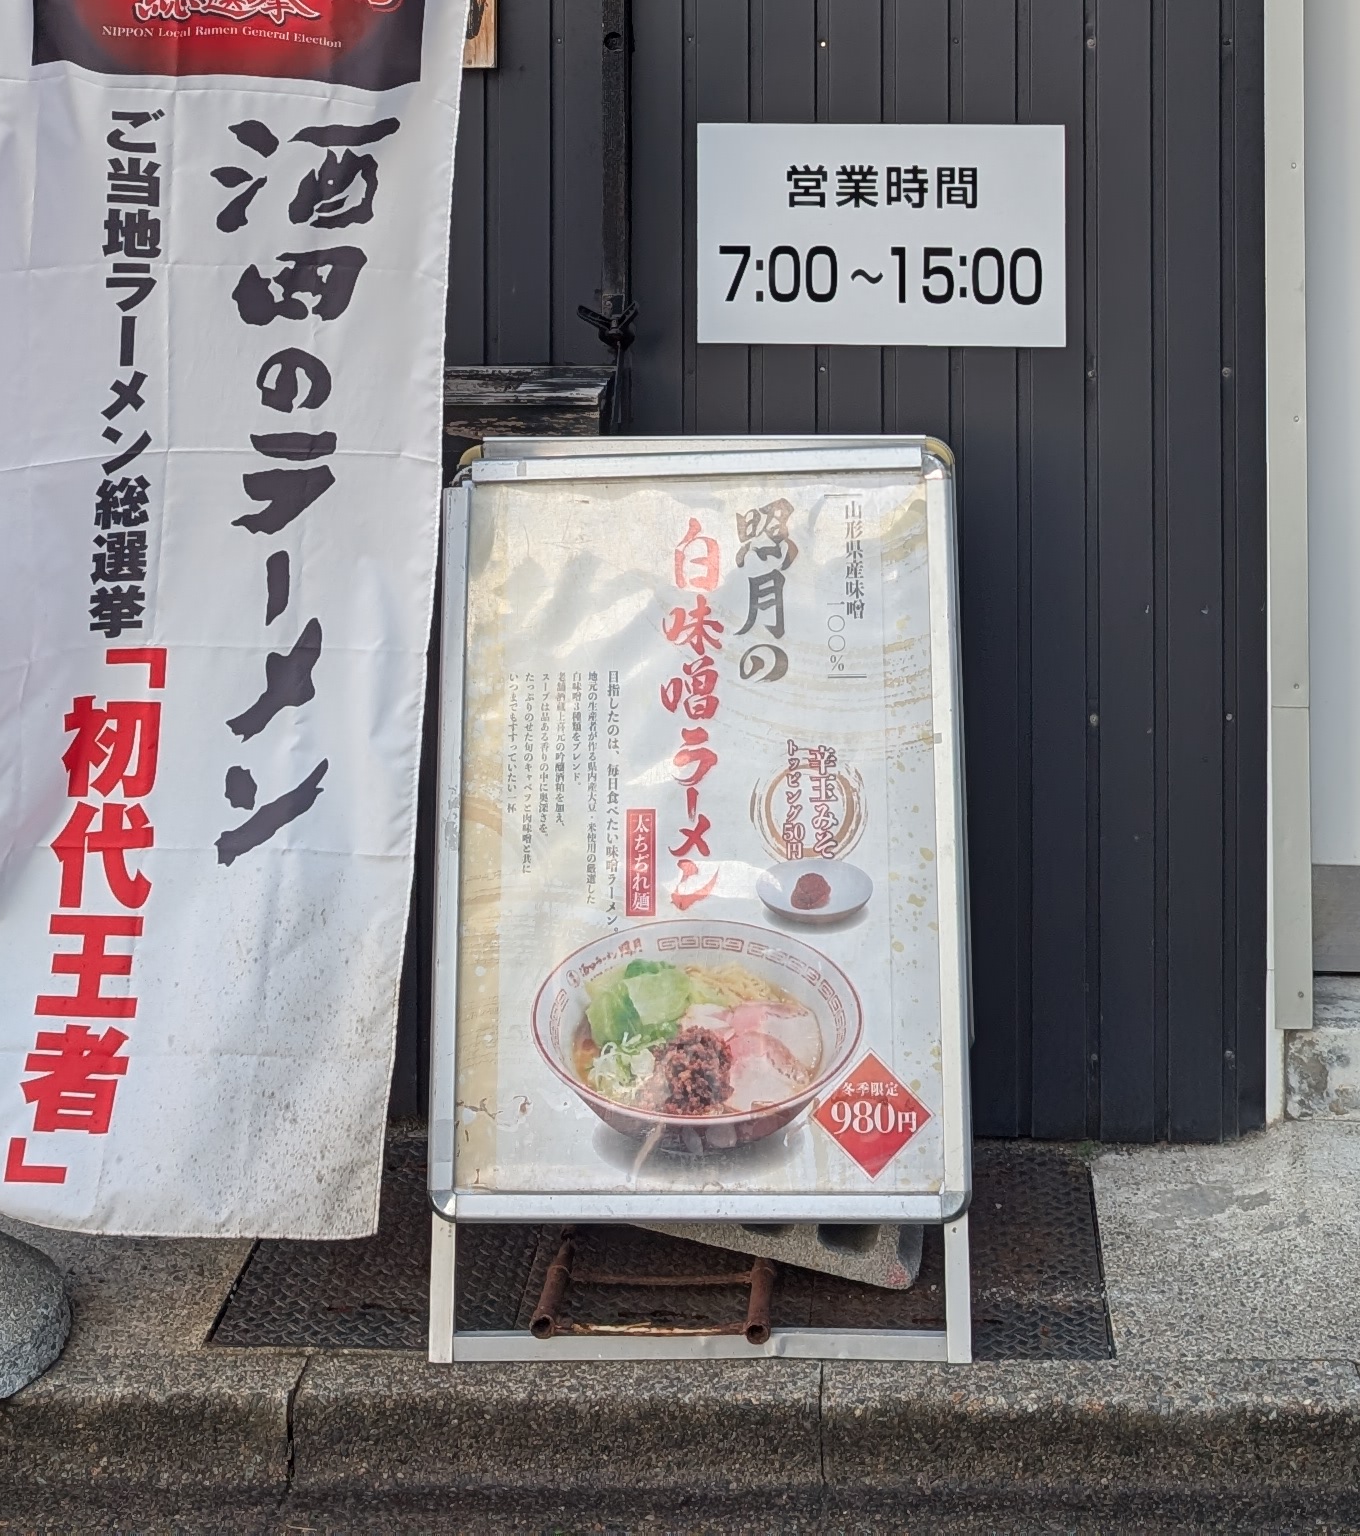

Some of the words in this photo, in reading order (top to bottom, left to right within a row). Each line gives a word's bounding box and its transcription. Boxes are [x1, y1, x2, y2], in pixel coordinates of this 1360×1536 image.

[102, 25, 154, 37] NIPPON
[158, 27, 191, 37] Local
[195, 26, 238, 36] Ramen
[242, 26, 290, 41] General
[293, 33, 342, 48] Election
[786, 164, 979, 209] 営業時間
[211, 117, 401, 867] 酒田のラーメン
[733, 497, 799, 684] 照月の
[844, 500, 866, 619] 山形県産味噌
[659, 517, 725, 911] 白味噌ラーメン
[782, 739, 806, 861] トッピング50円
[808, 745, 839, 860] 辛玉みそ
[631, 814, 651, 911] 太ちぢれ麺
[830, 1100, 917, 1135] 980円
[842, 1081, 899, 1097] 冬季限定
